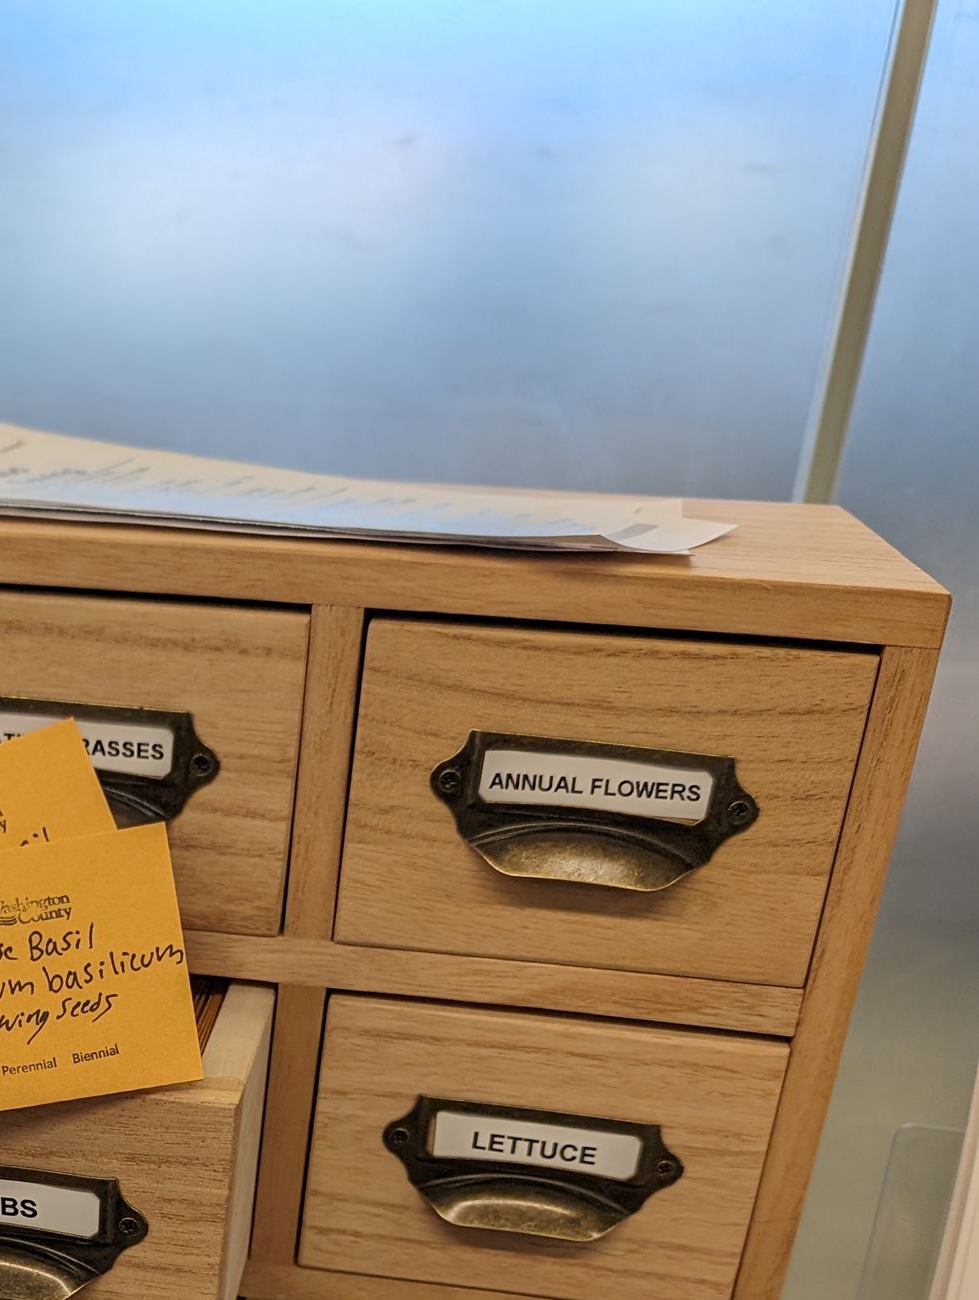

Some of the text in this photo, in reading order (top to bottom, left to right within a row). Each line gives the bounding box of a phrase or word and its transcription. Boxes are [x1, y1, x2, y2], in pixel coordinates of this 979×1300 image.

[81, 737, 165, 761] RASSES
[488, 772, 702, 802] ANNUAL FLOWERS
[28, 922, 94, 962] Basil
[42, 944, 185, 993] basilicum
[1, 1057, 57, 1077] Perennial
[72, 1043, 120, 1065] Biennial
[471, 1131, 598, 1166] LETTUCE
